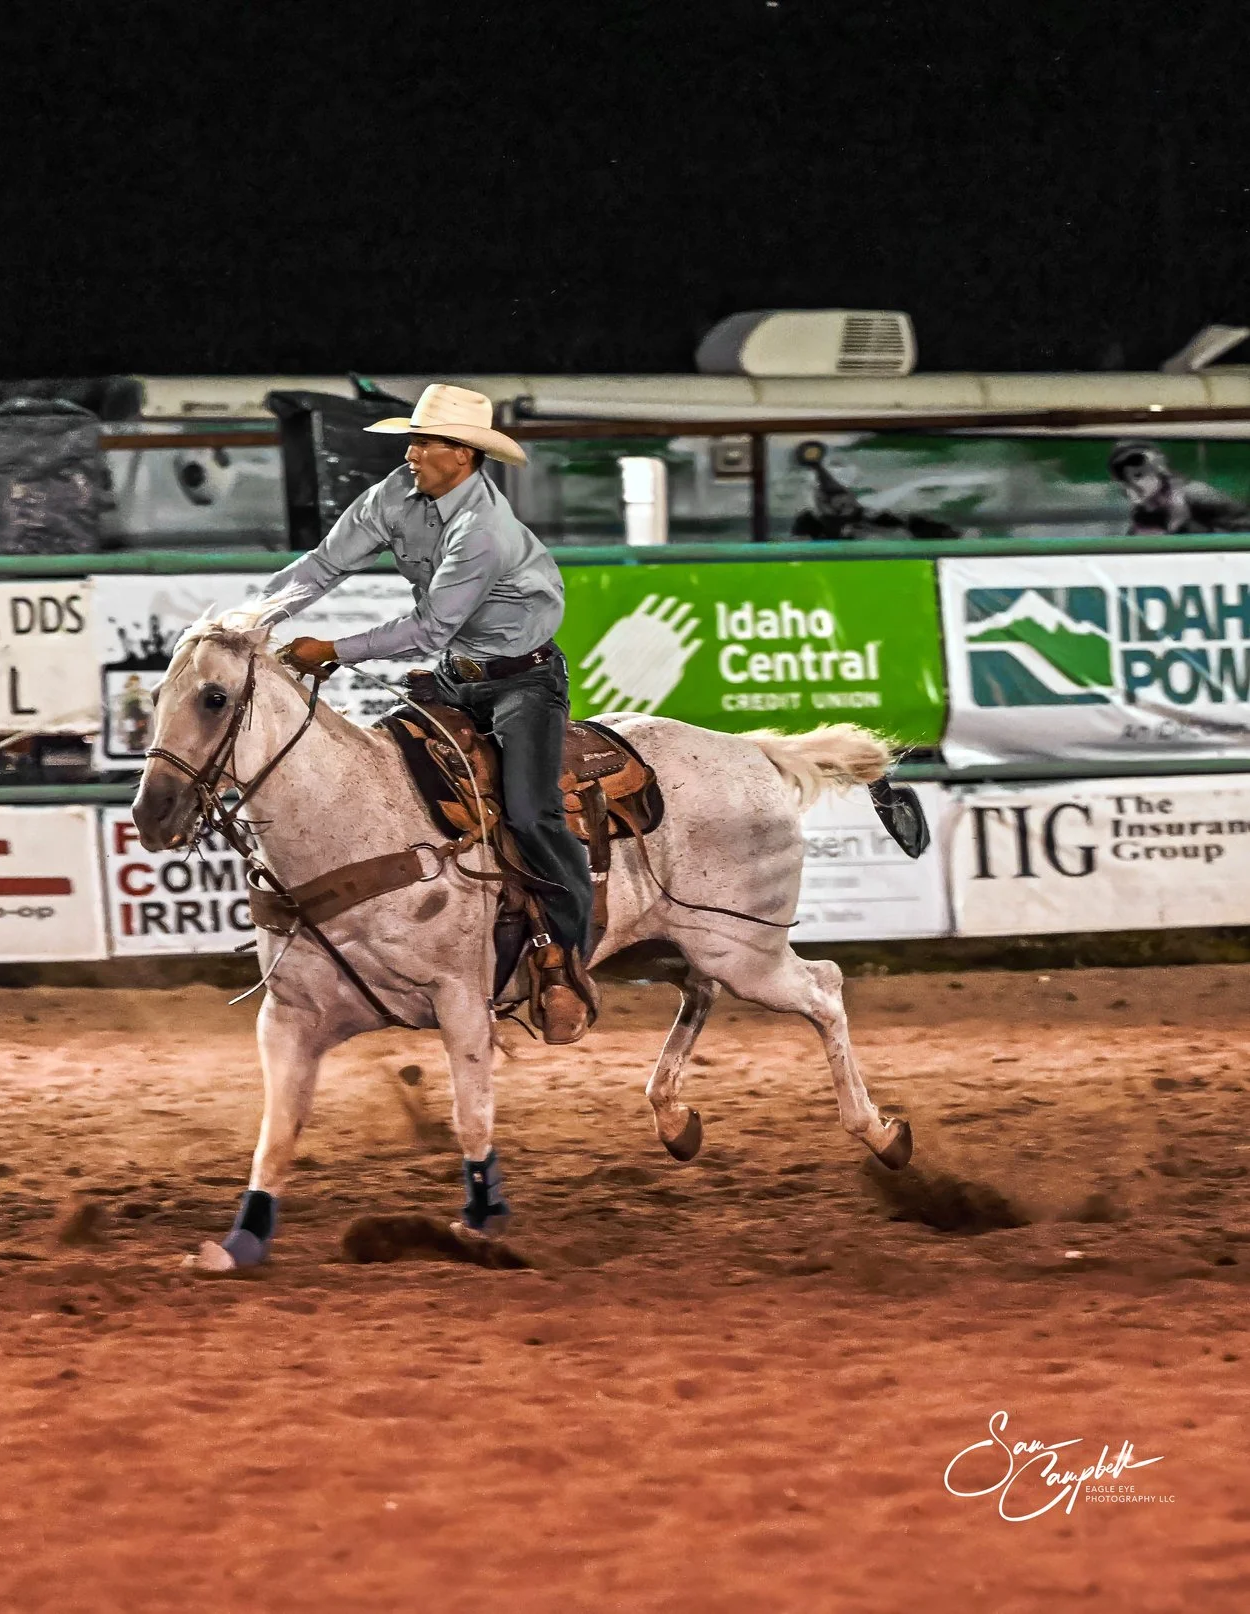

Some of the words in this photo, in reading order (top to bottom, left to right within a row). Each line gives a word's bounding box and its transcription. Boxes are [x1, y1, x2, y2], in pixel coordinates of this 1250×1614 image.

[10, 595, 85, 636] DDS
[716, 601, 835, 640] Idaho
[717, 640, 882, 684] Central
[721, 693, 801, 711] CREDIT
[810, 692, 882, 709] UNION
[1107, 796, 1175, 815] The
[970, 802, 1099, 879] TIG
[1111, 819, 1250, 838] Insuran
[1111, 841, 1225, 864] Group
